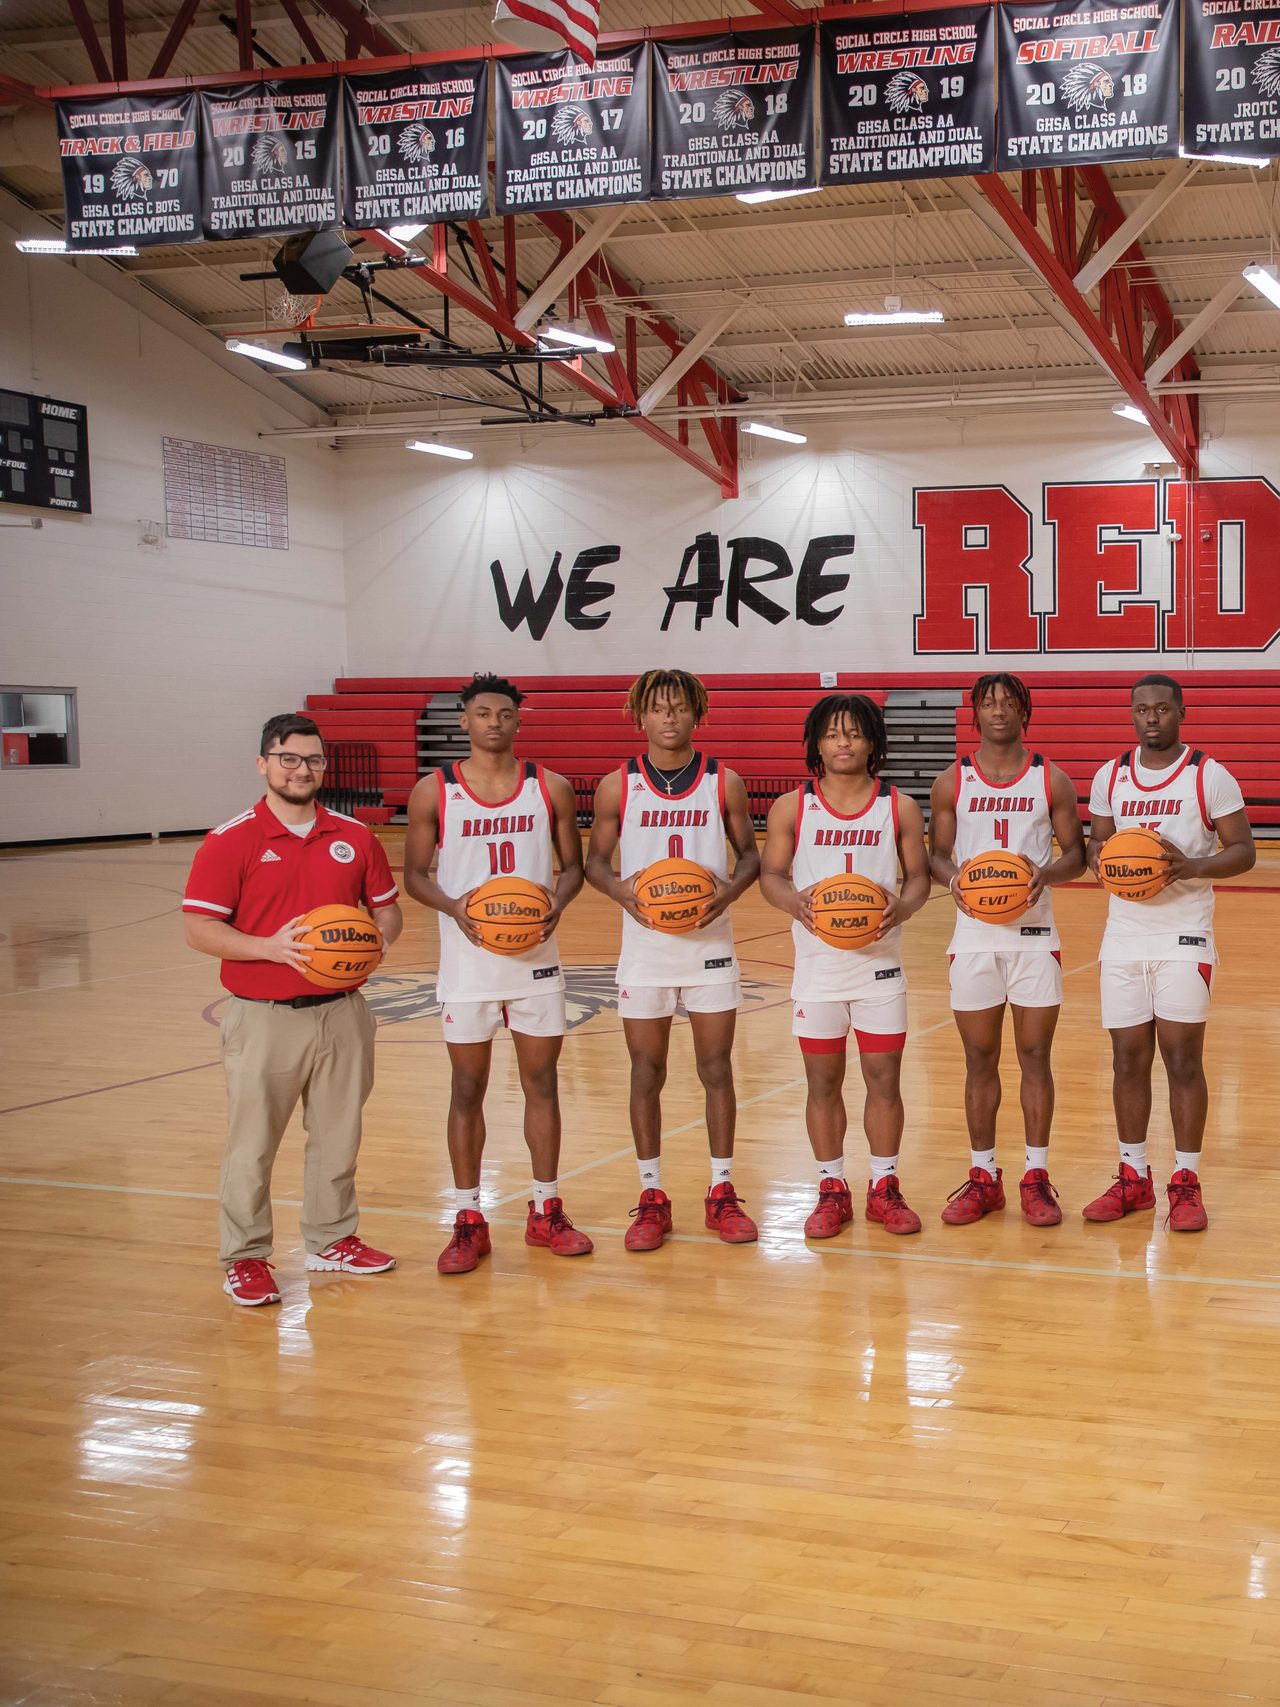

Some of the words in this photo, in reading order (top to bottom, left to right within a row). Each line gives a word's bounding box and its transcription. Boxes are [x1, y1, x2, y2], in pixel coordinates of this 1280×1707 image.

[1014, 17, 1050, 33] SOCIAL
[1053, 12, 1091, 28] CIRCLE
[1093, 8, 1120, 24] HIGH
[1122, 4, 1162, 22] SCHOOL
[1202, 2, 1242, 17] SOCIAL
[836, 33, 871, 50] SOCIAL
[873, 30, 909, 45] CIRCLE
[911, 28, 937, 41] HIGH
[939, 25, 977, 40] SCHOOL
[1016, 29, 1160, 65] SOFTBALL
[668, 55, 701, 70] SOCIAL
[703, 51, 735, 63] CIRCLE
[737, 48, 763, 61] HIGH
[765, 44, 800, 58] SCHOOL
[837, 42, 976, 75] WRESTLING
[512, 72, 542, 87] SOCIAL
[544, 68, 573, 82] CIRCLE
[597, 59, 633, 72] SCHOOL
[668, 60, 799, 93] WRESTLING
[1215, 67, 1246, 92] 20
[356, 90, 388, 103] SOCIAL
[390, 87, 418, 99] CIRCLE
[420, 83, 441, 95] HIGH
[442, 79, 475, 93] SCHOOL
[512, 76, 633, 110] WRESTLING
[849, 84, 877, 107] 20
[939, 76, 964, 99] 19
[1026, 82, 1055, 105] 20
[1121, 73, 1147, 97] 18
[211, 101, 236, 114] SOCIAL
[238, 99, 269, 110] CIRCLE
[272, 96, 291, 108] HIGH
[294, 94, 326, 106] SCHOOL
[358, 96, 473, 126] WRESTLING
[679, 102, 705, 124] 20
[764, 94, 788, 115] 18
[1234, 100, 1278, 118] JROTC
[70, 114, 97, 128] SOCIAL
[100, 112, 130, 125] CIRCLE
[132, 110, 150, 122] HIGH
[152, 108, 184, 122] SCHOOL
[212, 110, 326, 137] WRESTLING
[523, 119, 547, 141] 20
[600, 109, 624, 130] 17
[857, 121, 890, 134] GHSA
[894, 117, 933, 131] CLASS
[936, 115, 954, 128] AA
[1036, 116, 1071, 132] GHSA
[1074, 114, 1117, 130] CLASS
[1120, 111, 1138, 126] AA
[60, 136, 123, 156] TRACK
[124, 136, 141, 152] &
[143, 130, 196, 151] FIELD
[368, 135, 390, 156] 20
[445, 128, 465, 149] 16
[688, 137, 719, 151] GHSA
[722, 133, 759, 148] CLASS
[761, 130, 779, 144] AA
[831, 134, 914, 151] TRADITIONAL
[918, 131, 945, 145] AND
[948, 127, 982, 142] DUAL
[1008, 135, 1064, 157] STATE
[1068, 125, 1168, 153] CHAMPIONS
[1196, 121, 1254, 143] STATE
[223, 146, 244, 167] 20
[295, 140, 316, 160] 15
[530, 152, 558, 166] GHSA
[561, 149, 597, 162] CLASS
[600, 146, 617, 159] AA
[663, 151, 741, 167] TRADITIONAL
[744, 148, 770, 162] AND
[773, 144, 805, 159] DUAL
[830, 151, 883, 175] STATE
[887, 144, 983, 170] CHAMPIONS
[82, 174, 104, 193] 19
[156, 168, 178, 188] 70
[376, 168, 405, 181] GHSA
[408, 165, 439, 178] CLASS
[442, 163, 458, 175] AA
[507, 164, 581, 182] TRADITIONAL
[584, 162, 608, 174] AND
[611, 158, 640, 172] DUAL
[661, 166, 712, 190] STATE
[716, 159, 806, 186] CHAMPIONS
[231, 180, 258, 192] GHSA
[261, 178, 293, 191] CLASS
[296, 175, 310, 187] AA
[356, 183, 426, 198] TRADITIONAL
[428, 178, 449, 192] AND
[452, 175, 481, 188] DUAL
[506, 182, 552, 204] STATE
[556, 173, 642, 201] CHAMPIONS
[82, 204, 110, 218] GHSA
[112, 202, 144, 216] CLASS
[146, 202, 153, 214] C
[156, 200, 180, 213] BOYS
[212, 190, 280, 209] TRADITIONAL
[283, 189, 303, 201] AND
[305, 188, 334, 200] DUAL
[355, 198, 400, 220] STATE
[404, 190, 481, 216] CHAMPIONS
[71, 220, 114, 238] STATE
[118, 214, 194, 235] CHAMPIONS
[211, 210, 255, 230] STATE
[258, 202, 336, 226] CHAMPIONS
[41, 403, 77, 419] HOME
[0, 460, 27, 469] -FOUL
[50, 467, 74, 477] FOULS
[51, 499, 77, 508] POINTS
[491, 544, 621, 641] WE
[660, 531, 855, 632] ARE
[968, 797, 1034, 813] REDSKINS
[1121, 800, 1183, 816] REDSKINS
[462, 815, 535, 837] REDSKINS
[640, 810, 709, 827] REDSKINS
[814, 830, 882, 846] REDSKINS
[994, 819, 1009, 848] 4
[668, 834, 683, 858] 0
[486, 841, 516, 875] 10
[844, 853, 853, 873] 1
[968, 867, 1018, 882] Wilson
[1105, 864, 1154, 878] Wilson
[649, 882, 702, 899] Wilson
[822, 889, 875, 905] Wilson
[979, 895, 1009, 906] EVO
[485, 902, 541, 918] Wilson
[660, 907, 698, 921] NCAA
[831, 916, 869, 929] NCAA
[320, 928, 378, 944] Wilson
[495, 933, 529, 942] EVO
[332, 960, 368, 972] EVO
